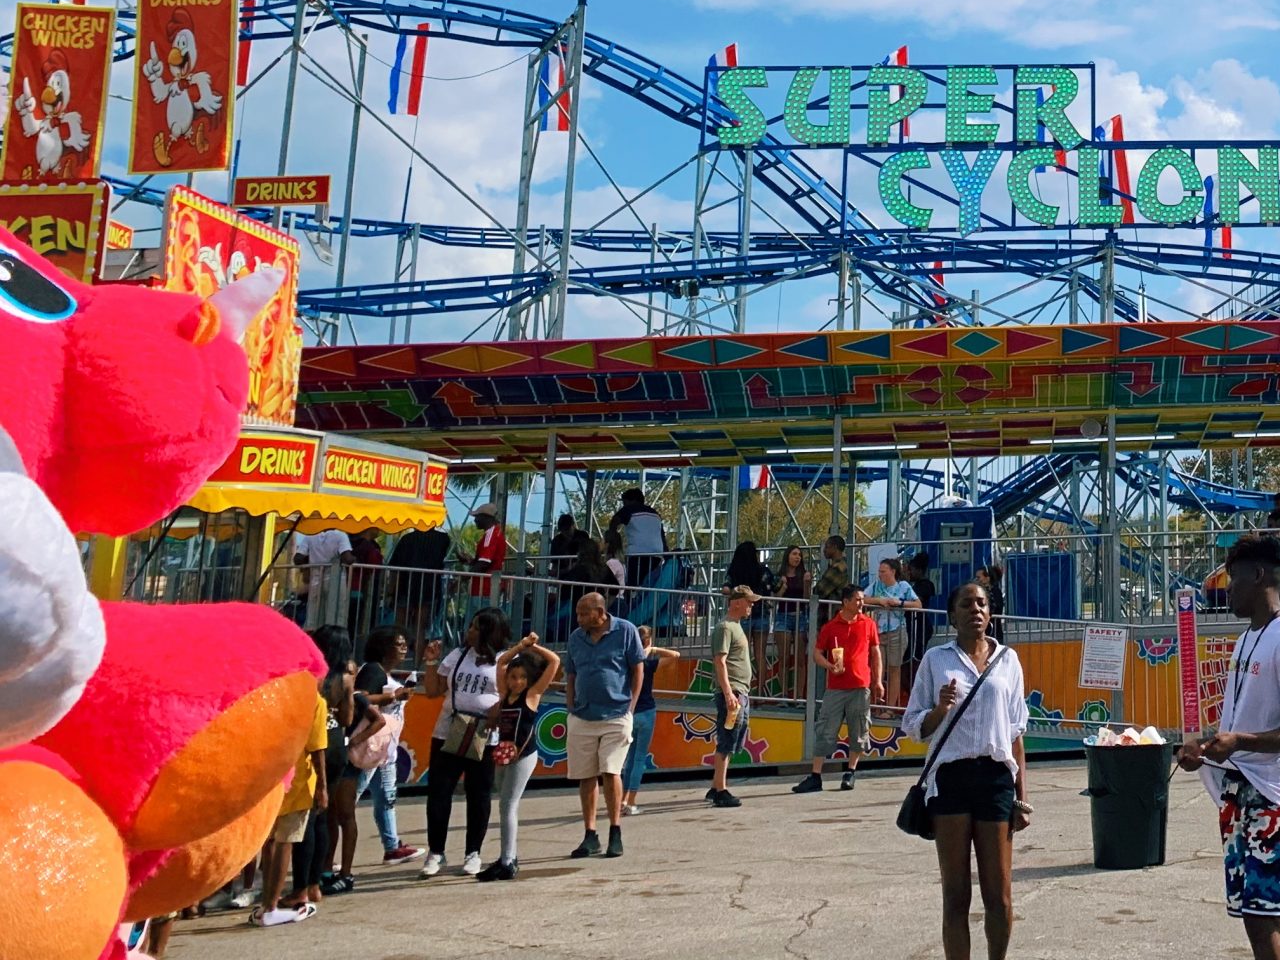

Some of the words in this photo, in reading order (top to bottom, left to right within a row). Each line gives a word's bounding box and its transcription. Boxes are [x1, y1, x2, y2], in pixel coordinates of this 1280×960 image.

[22, 12, 106, 34] CHICKEN
[31, 29, 96, 49] WINGS
[716, 65, 1087, 149] SUPER
[246, 180, 318, 201] DRINKS
[108, 226, 128, 249] INGS
[239, 446, 306, 477] DRINKS
[325, 454, 377, 485] CHICKEN
[380, 463, 416, 491] WINGS
[427, 472, 444, 496] ICE
[1089, 628, 1122, 636] SAFETY
[457, 672, 489, 687] BOSS
